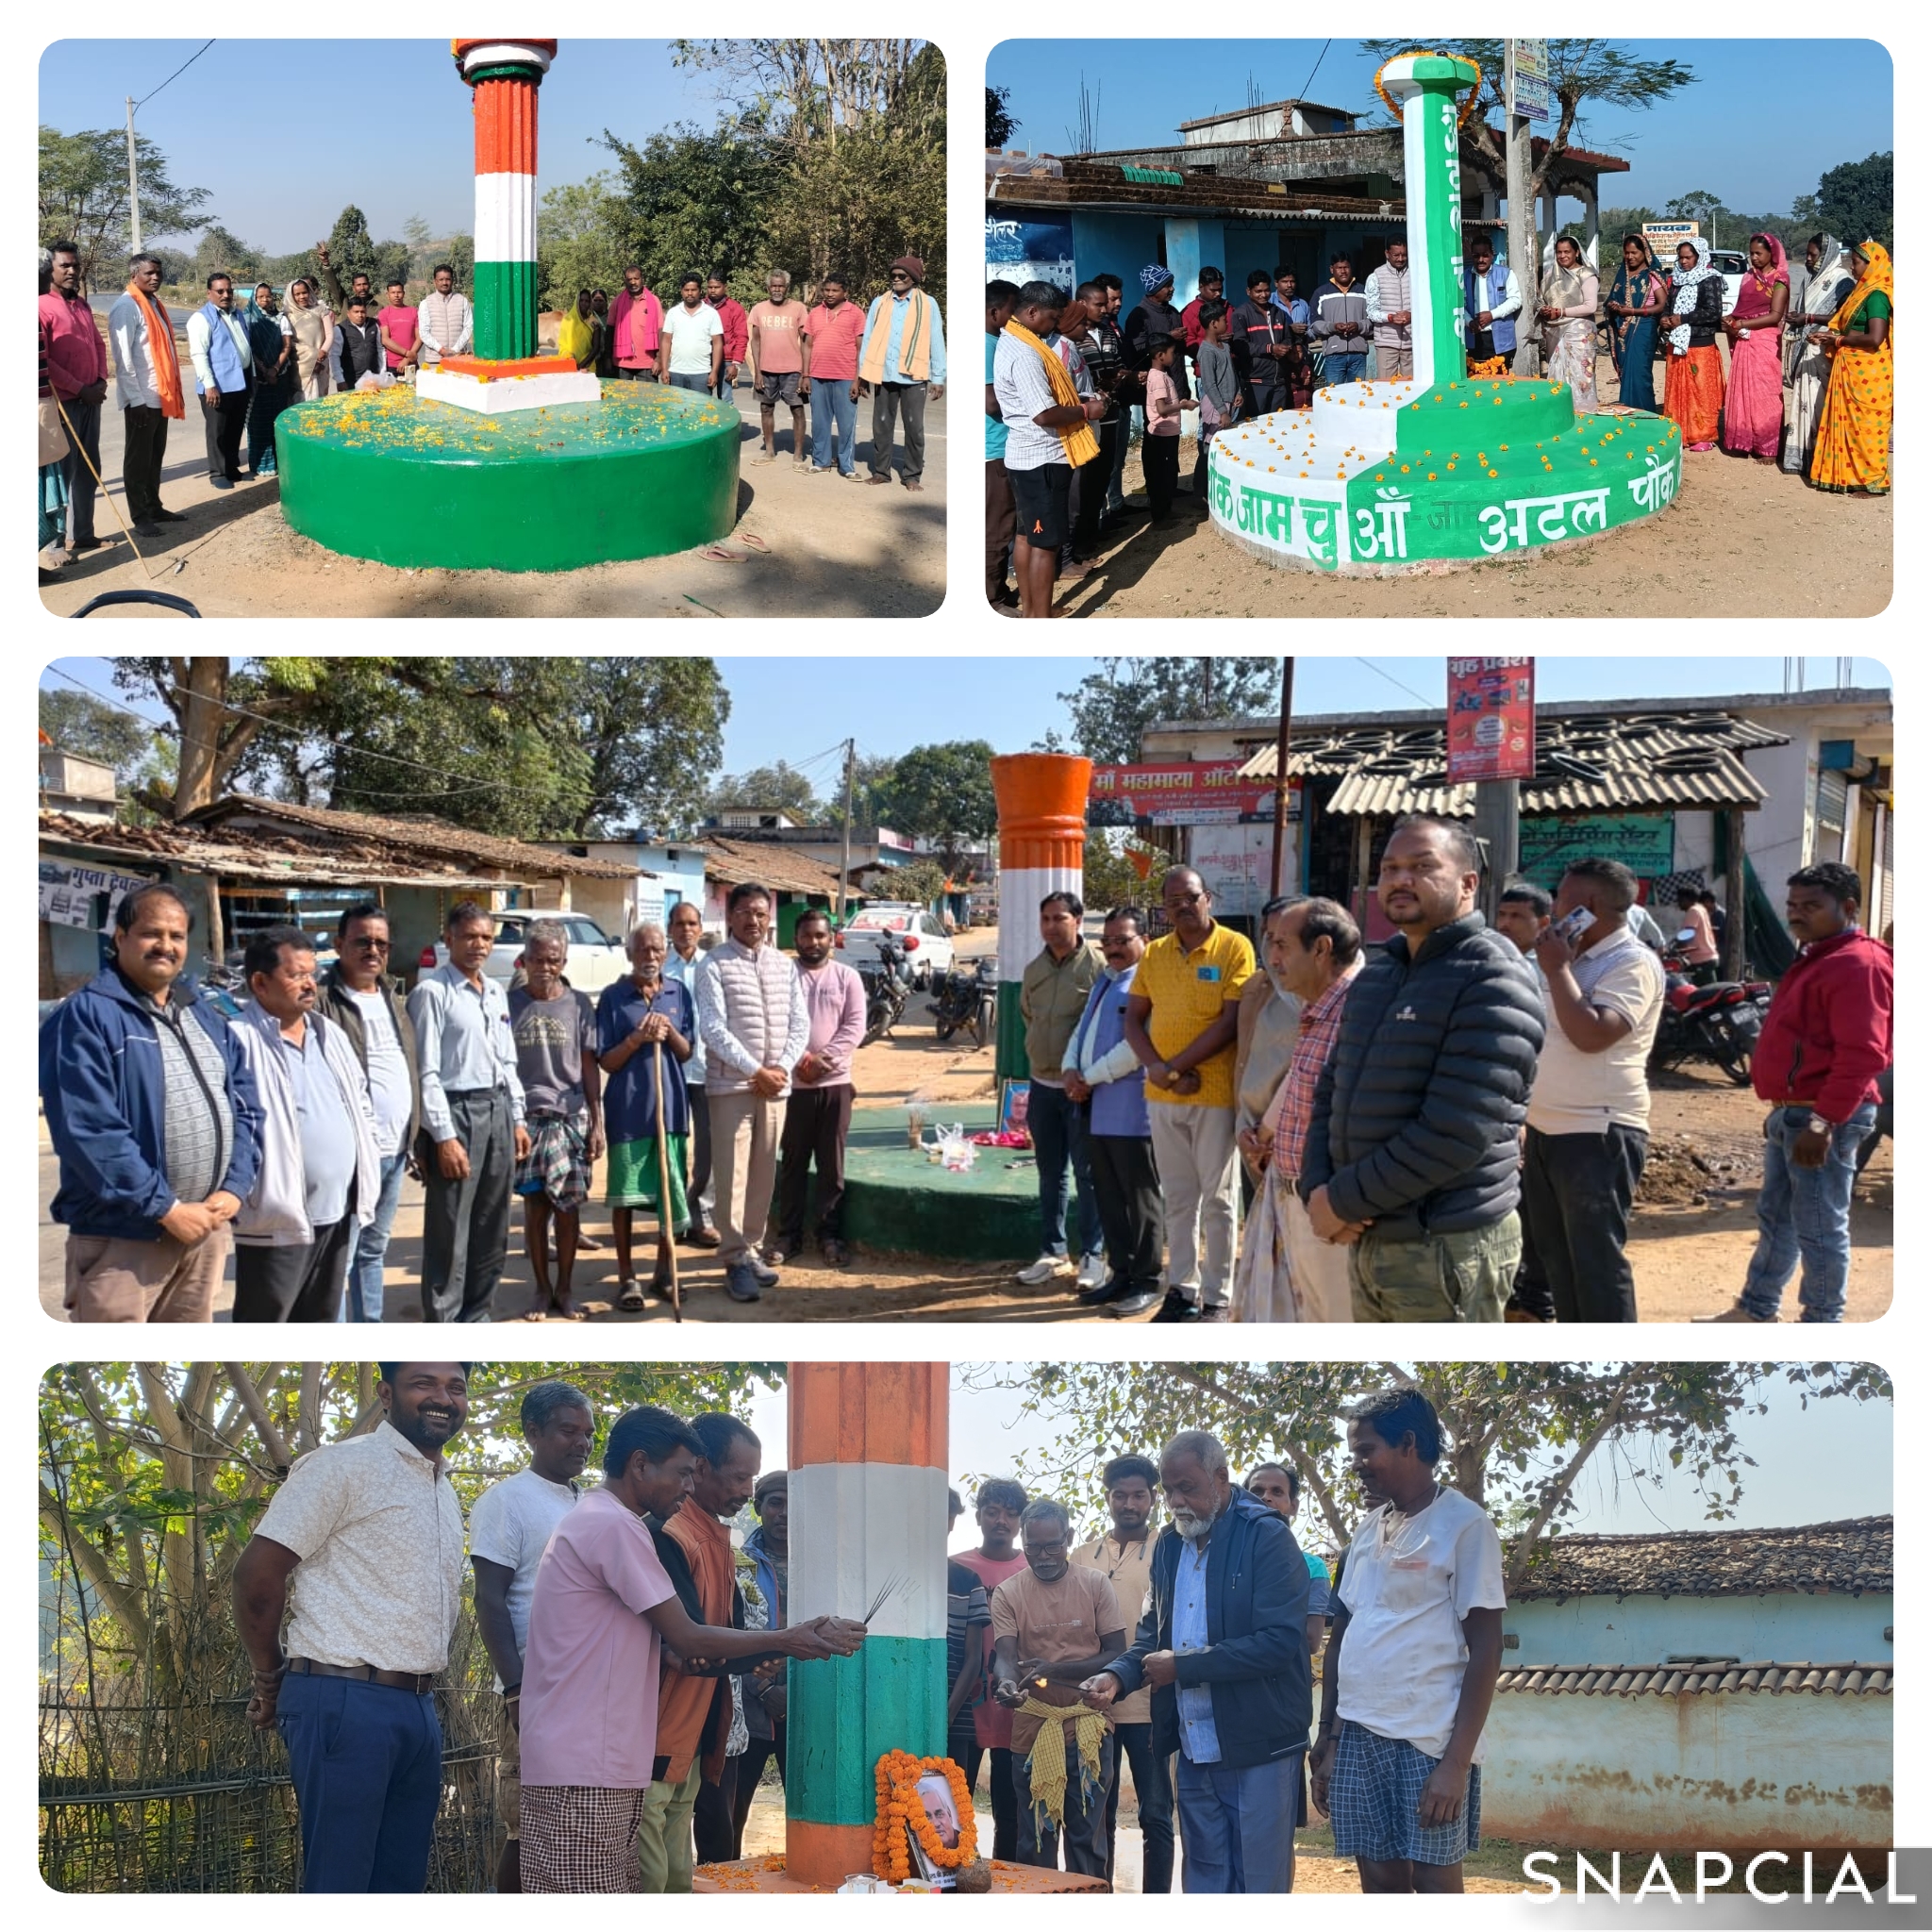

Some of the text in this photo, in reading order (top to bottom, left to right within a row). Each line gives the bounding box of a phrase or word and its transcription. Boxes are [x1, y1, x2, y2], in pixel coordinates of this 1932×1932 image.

[1645, 224, 1692, 232] नायक
[760, 315, 794, 329] REBEL
[1477, 487, 1610, 554] अटल
[1094, 769, 1116, 791] माँ
[1121, 772, 1194, 791] महामाया
[1200, 762, 1241, 788] ऑटो
[73, 867, 107, 889] गुप्ता
